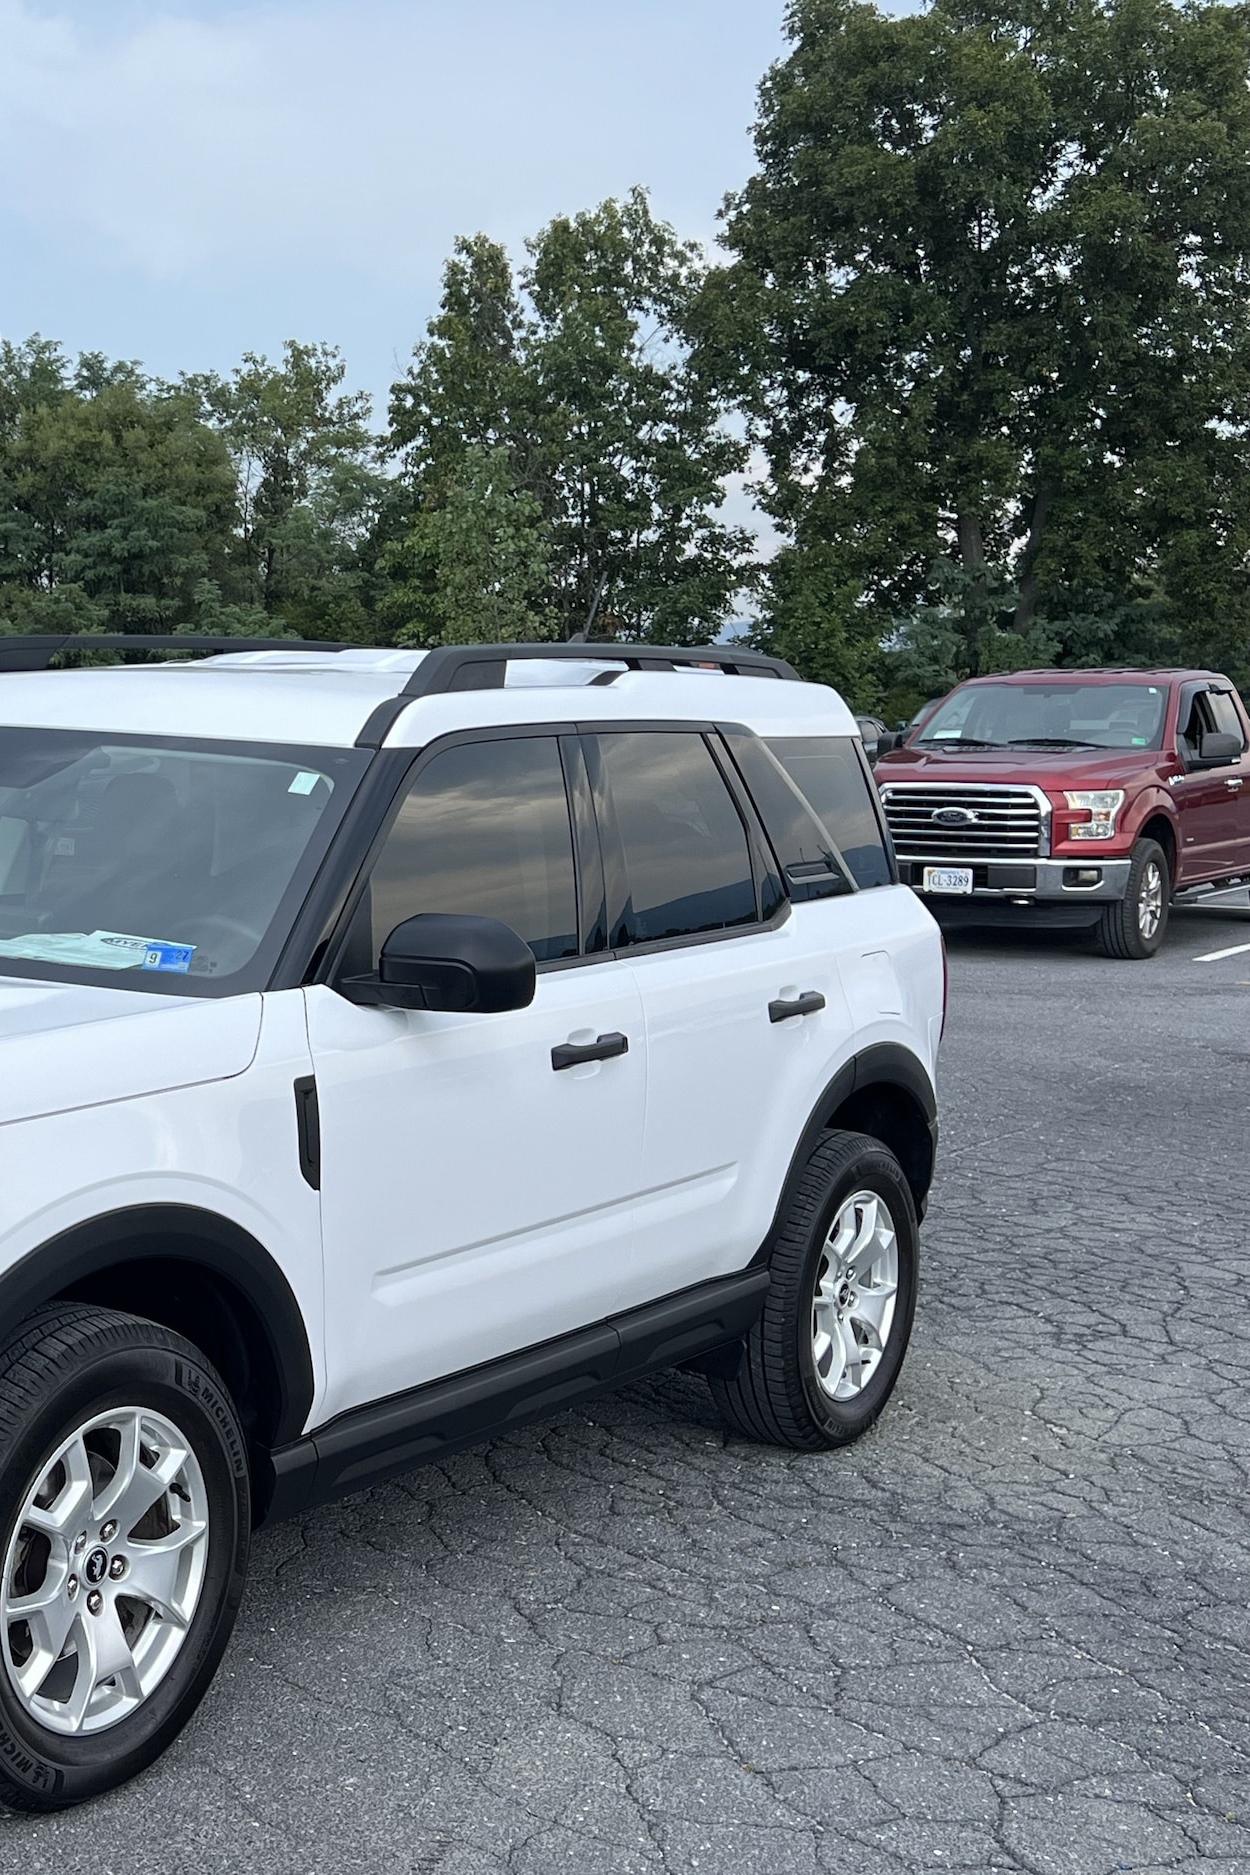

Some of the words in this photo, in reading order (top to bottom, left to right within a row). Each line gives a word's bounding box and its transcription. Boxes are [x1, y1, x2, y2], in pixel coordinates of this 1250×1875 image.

[149, 952, 158, 964] 9
[175, 950, 189, 961] 27
[200, 1386, 244, 1474] MICHELIN
